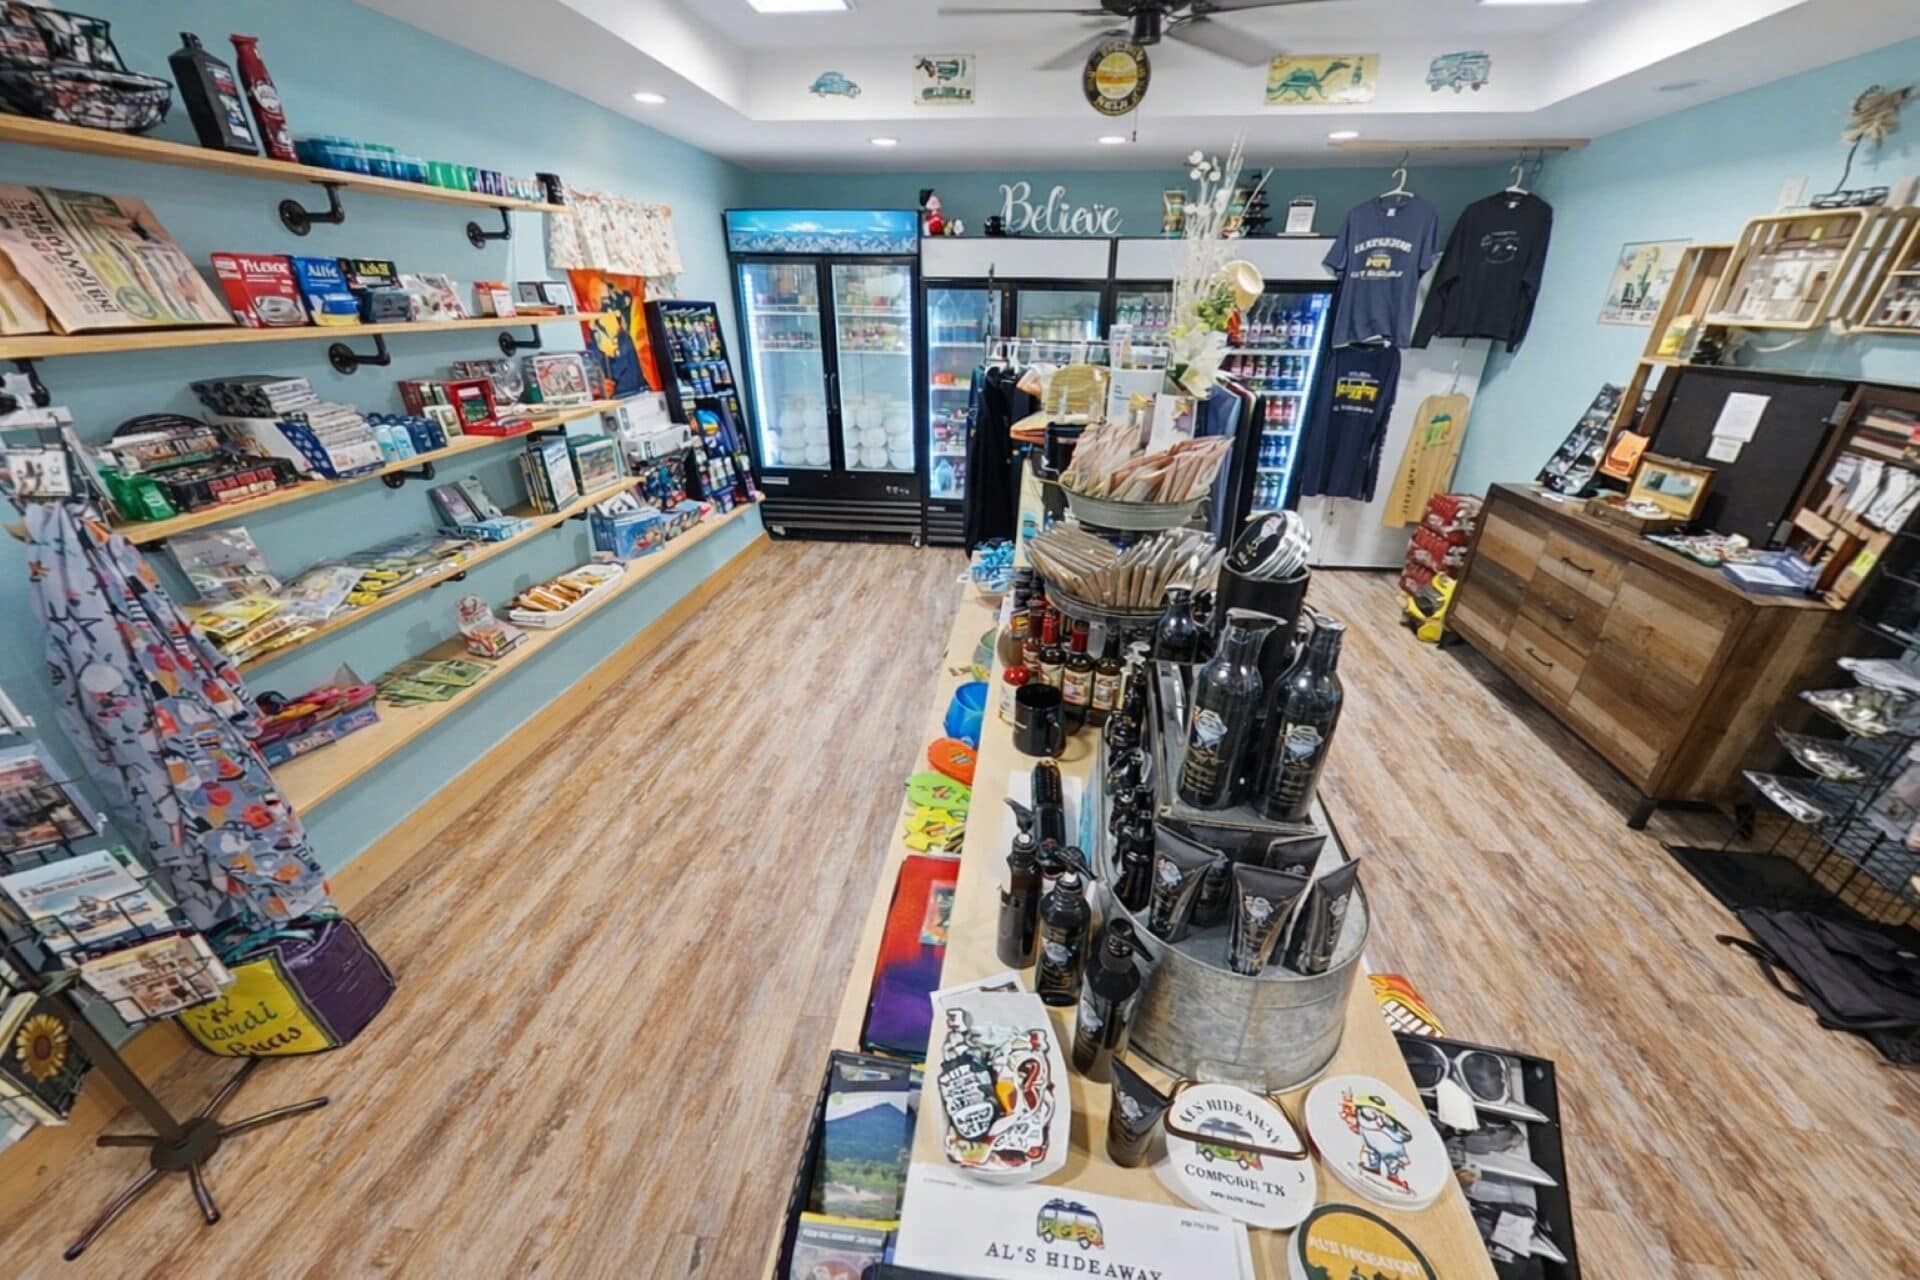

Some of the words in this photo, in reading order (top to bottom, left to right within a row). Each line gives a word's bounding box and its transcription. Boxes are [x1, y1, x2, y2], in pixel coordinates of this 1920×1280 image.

[999, 181, 1123, 234] Believe
[985, 1243, 1036, 1263] AL'S
[1046, 1251, 1164, 1280] HIDEAWAY
